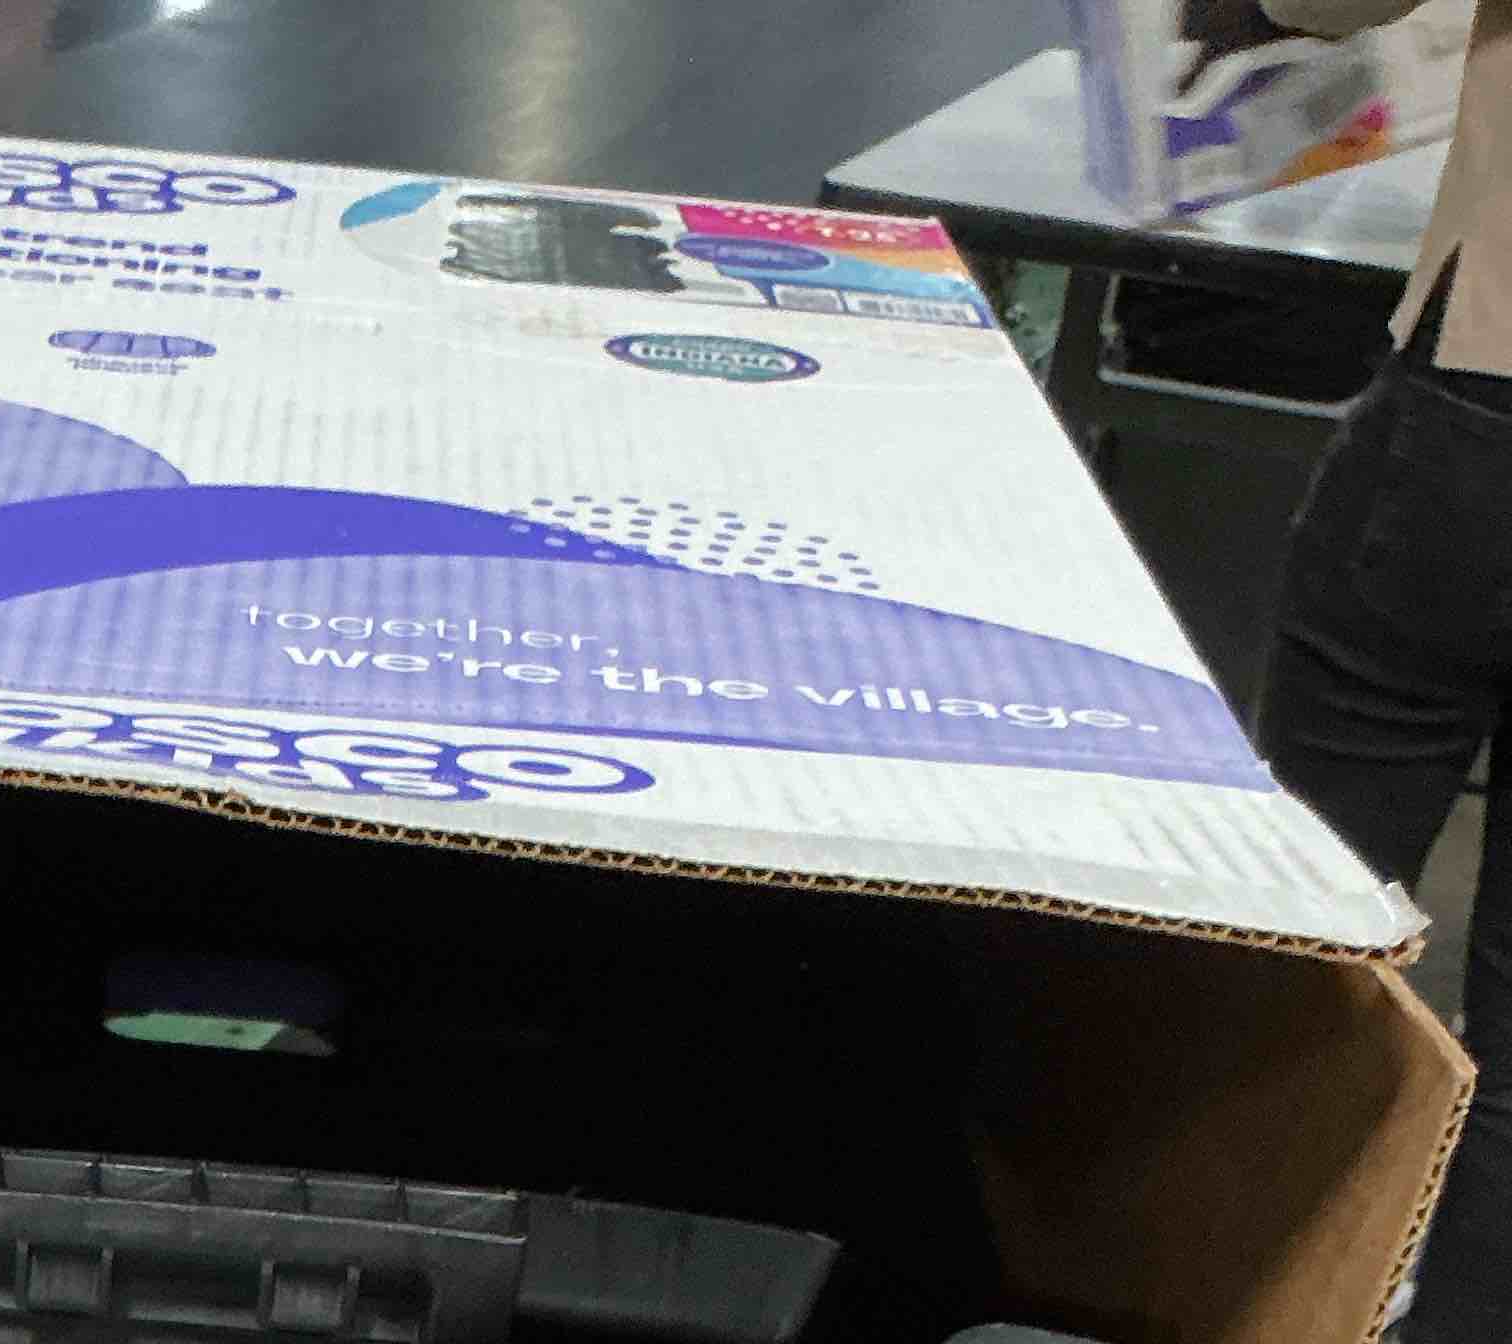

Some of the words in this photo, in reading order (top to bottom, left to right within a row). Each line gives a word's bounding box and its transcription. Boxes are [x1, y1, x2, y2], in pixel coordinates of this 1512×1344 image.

[110, 277, 294, 302] seat
[240, 604, 622, 658] together,
[283, 643, 563, 686] we're
[592, 663, 771, 704] the
[797, 683, 1162, 733] village.
